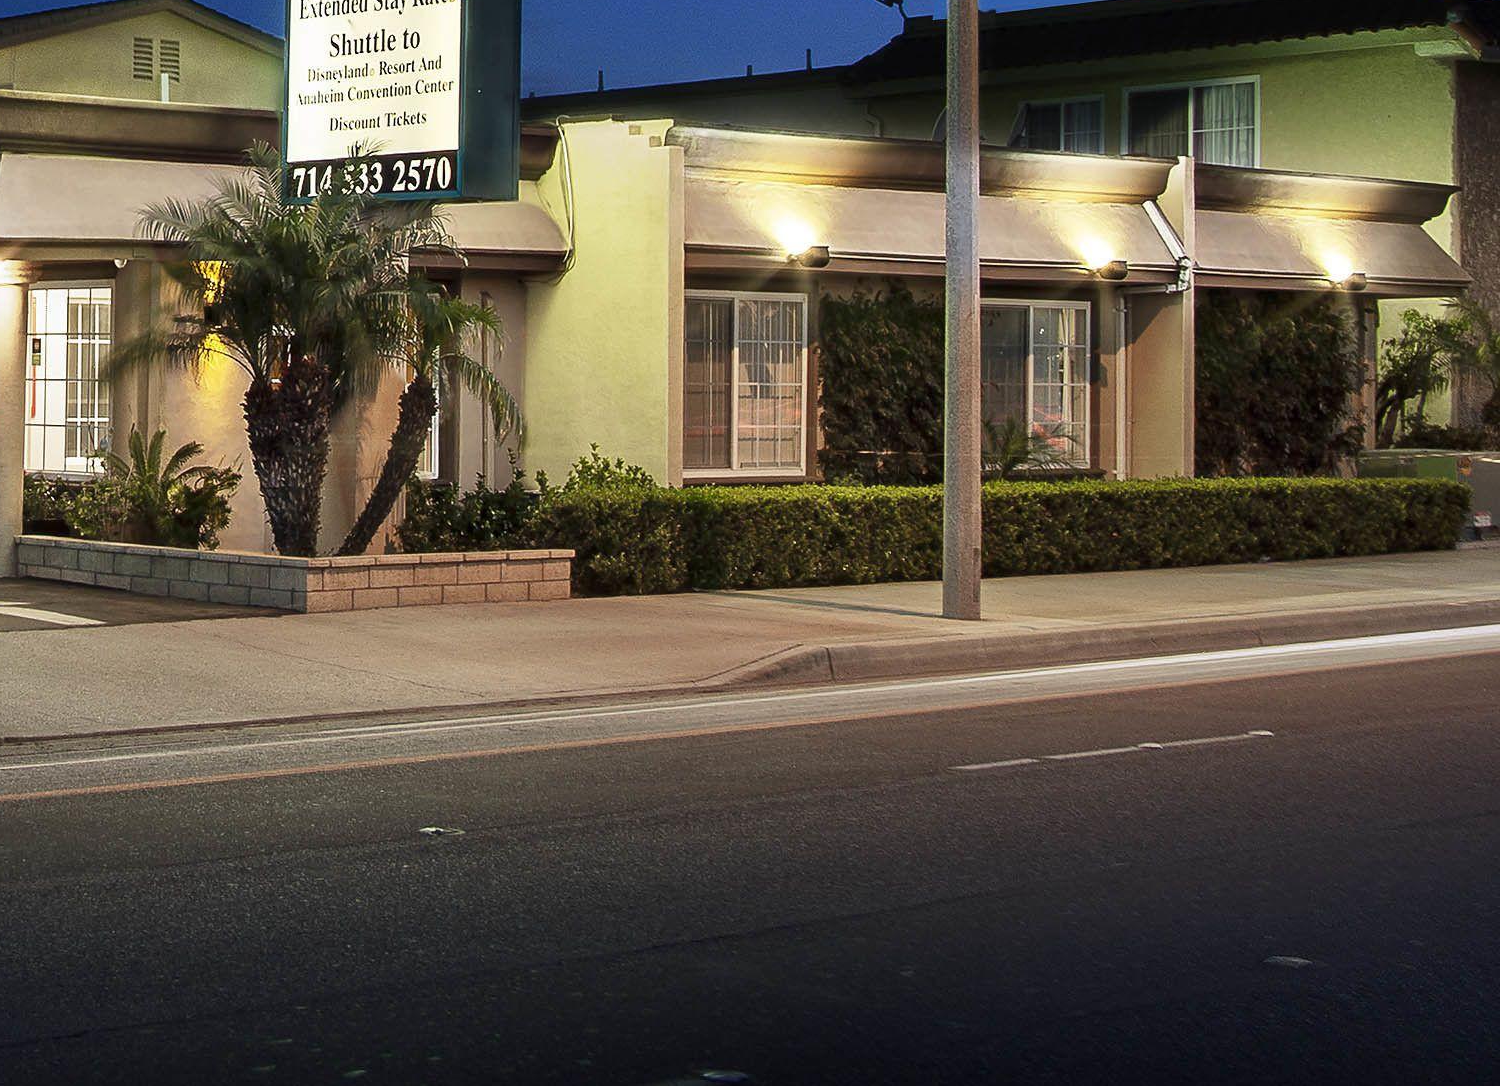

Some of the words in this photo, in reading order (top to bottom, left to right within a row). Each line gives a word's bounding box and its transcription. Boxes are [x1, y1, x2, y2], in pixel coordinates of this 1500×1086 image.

[329, 28, 397, 58] Shuttle
[403, 27, 421, 50] to
[379, 60, 415, 76] Resort
[418, 55, 442, 72] And
[297, 89, 344, 106] Anaheim
[347, 82, 412, 102] Convention
[415, 79, 455, 95] Center
[329, 116, 381, 132] Discount
[384, 111, 427, 127] Tickets
[293, 165, 332, 198] 714
[392, 156, 452, 192] 2570
